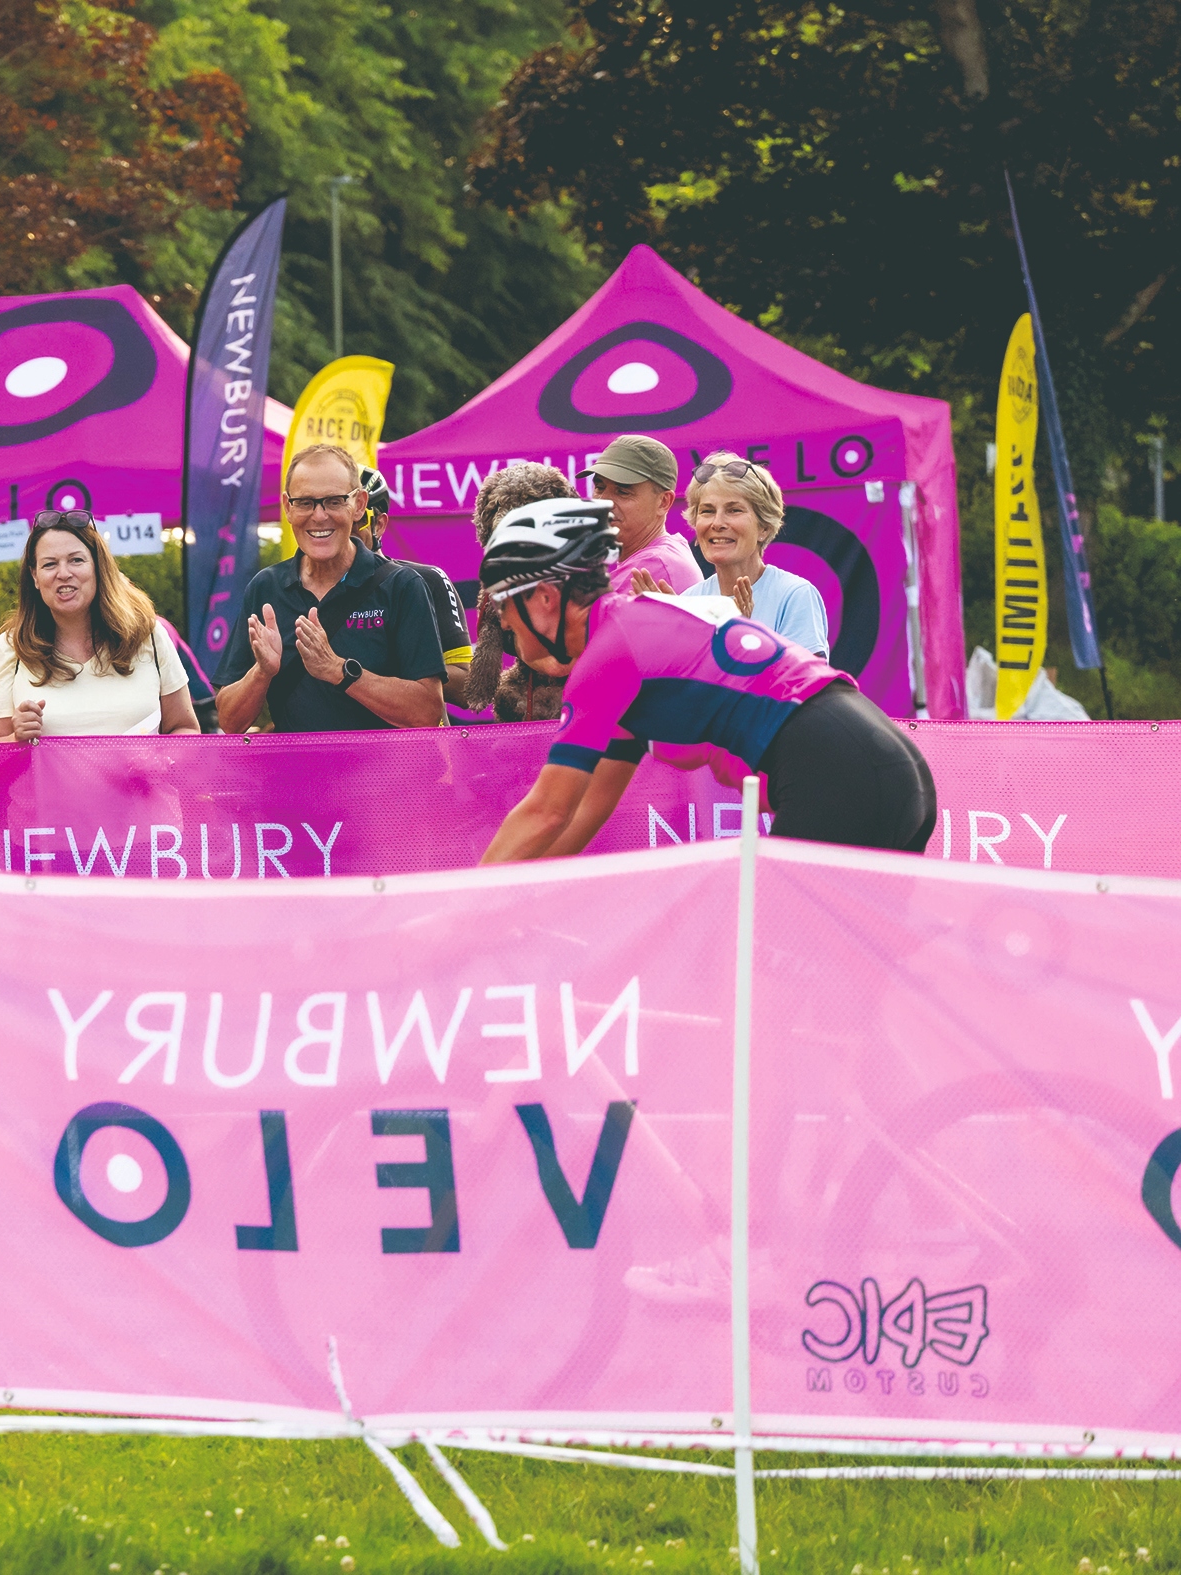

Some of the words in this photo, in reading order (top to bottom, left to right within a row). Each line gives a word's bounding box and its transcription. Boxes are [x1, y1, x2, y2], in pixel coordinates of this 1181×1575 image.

[220, 272, 257, 488] NEWBURY
[306, 417, 344, 440] RACE
[691, 434, 875, 483] ELO
[116, 524, 155, 542] U14
[431, 567, 465, 632] SCOTT
[346, 616, 385, 629] VELO
[349, 609, 385, 619] EWBURY
